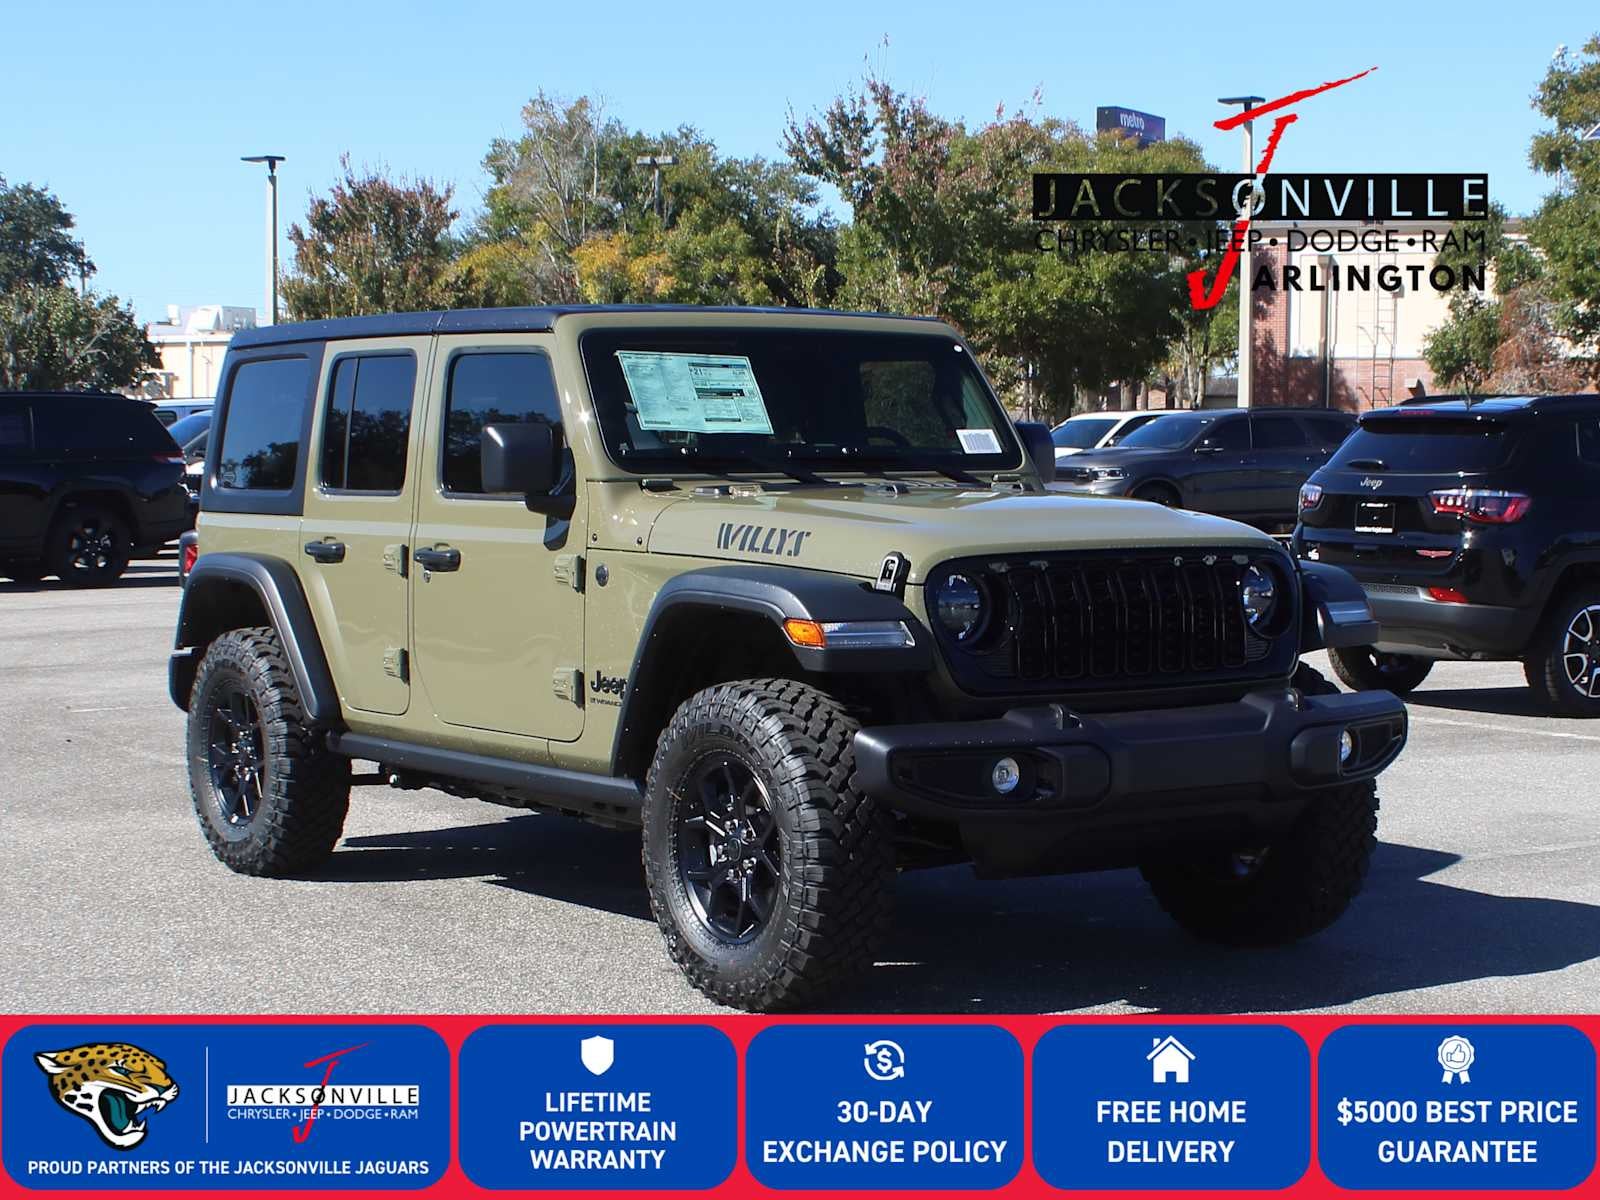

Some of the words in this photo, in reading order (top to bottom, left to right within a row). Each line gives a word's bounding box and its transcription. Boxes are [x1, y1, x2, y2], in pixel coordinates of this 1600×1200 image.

[1119, 112, 1145, 130] metro
[1360, 477, 1383, 490] Jeep
[717, 522, 812, 557] WILLYS
